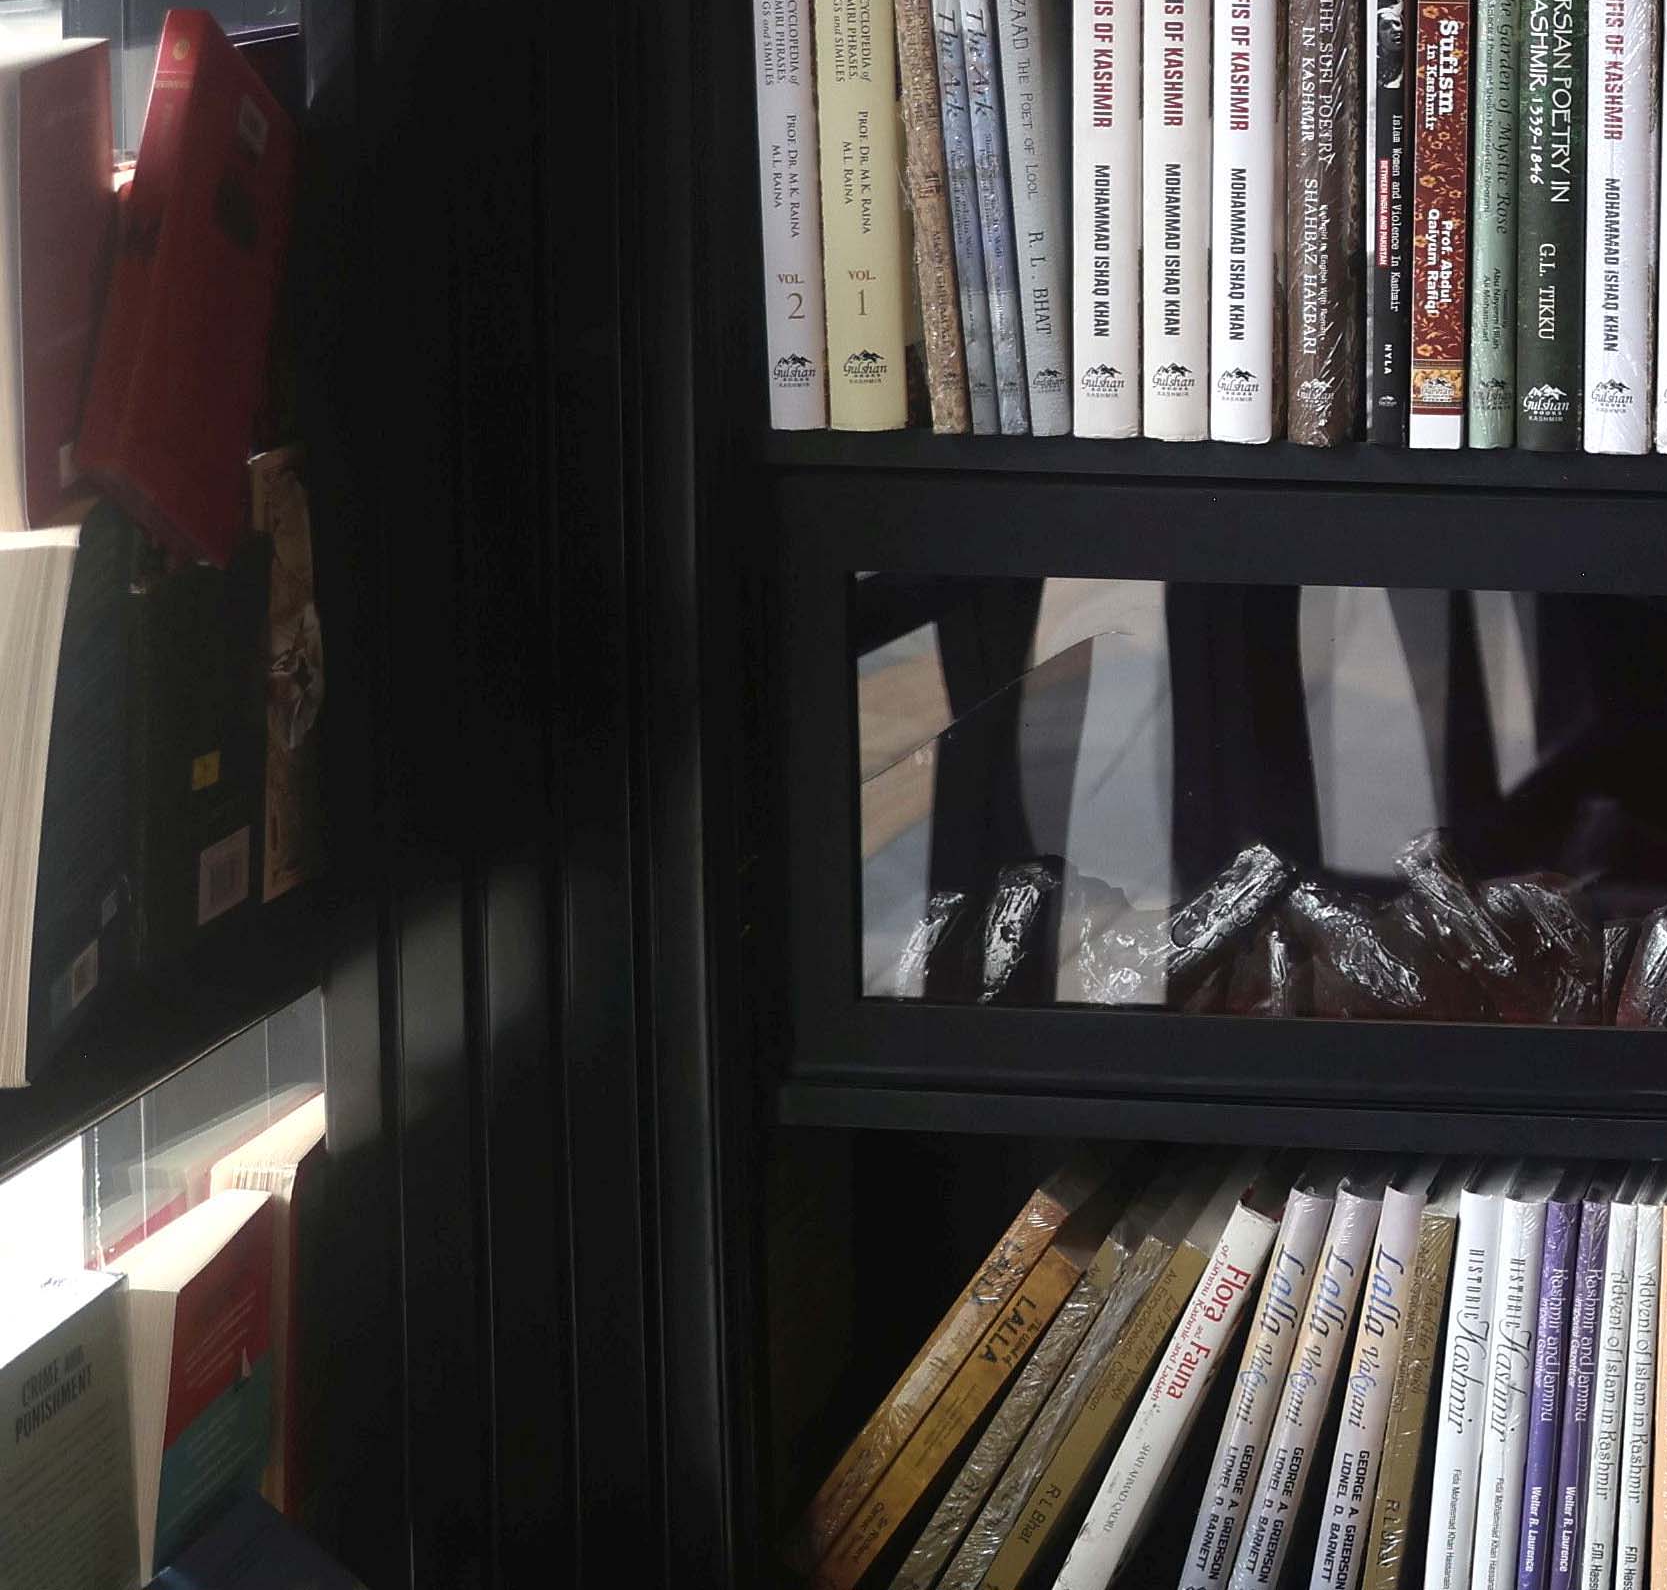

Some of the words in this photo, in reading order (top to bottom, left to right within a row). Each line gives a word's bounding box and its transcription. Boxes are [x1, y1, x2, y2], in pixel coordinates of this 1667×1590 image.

[1232, 25, 1250, 46] OF
[1230, 51, 1250, 131] KASHMIR
[1392, 115, 1402, 142] Islam
[1529, 98, 1544, 184] 1339-1846
[1550, 76, 1571, 174] POETRY
[1392, 146, 1402, 177] Women
[1392, 182, 1402, 200] and
[1551, 181, 1571, 202] IN
[1230, 168, 1247, 254] MOHAMMAD
[1391, 205, 1402, 250] Violence
[848, 270, 876, 280] VOL.
[1539, 244, 1556, 277] G.L.
[1228, 260, 1246, 300] ISHAQ
[1391, 272, 1401, 311] Kashmir
[856, 290, 867, 316] 1
[1539, 286, 1555, 339] TIKKU
[1229, 305, 1246, 340] KHAN
[844, 361, 887, 374] Gulshan
[1384, 344, 1392, 374] NYLA
[1369, 1245, 1405, 1338] Lalla
[1464, 1249, 1483, 1319] HISTORIC
[1448, 1310, 1489, 1434] Kashmir
